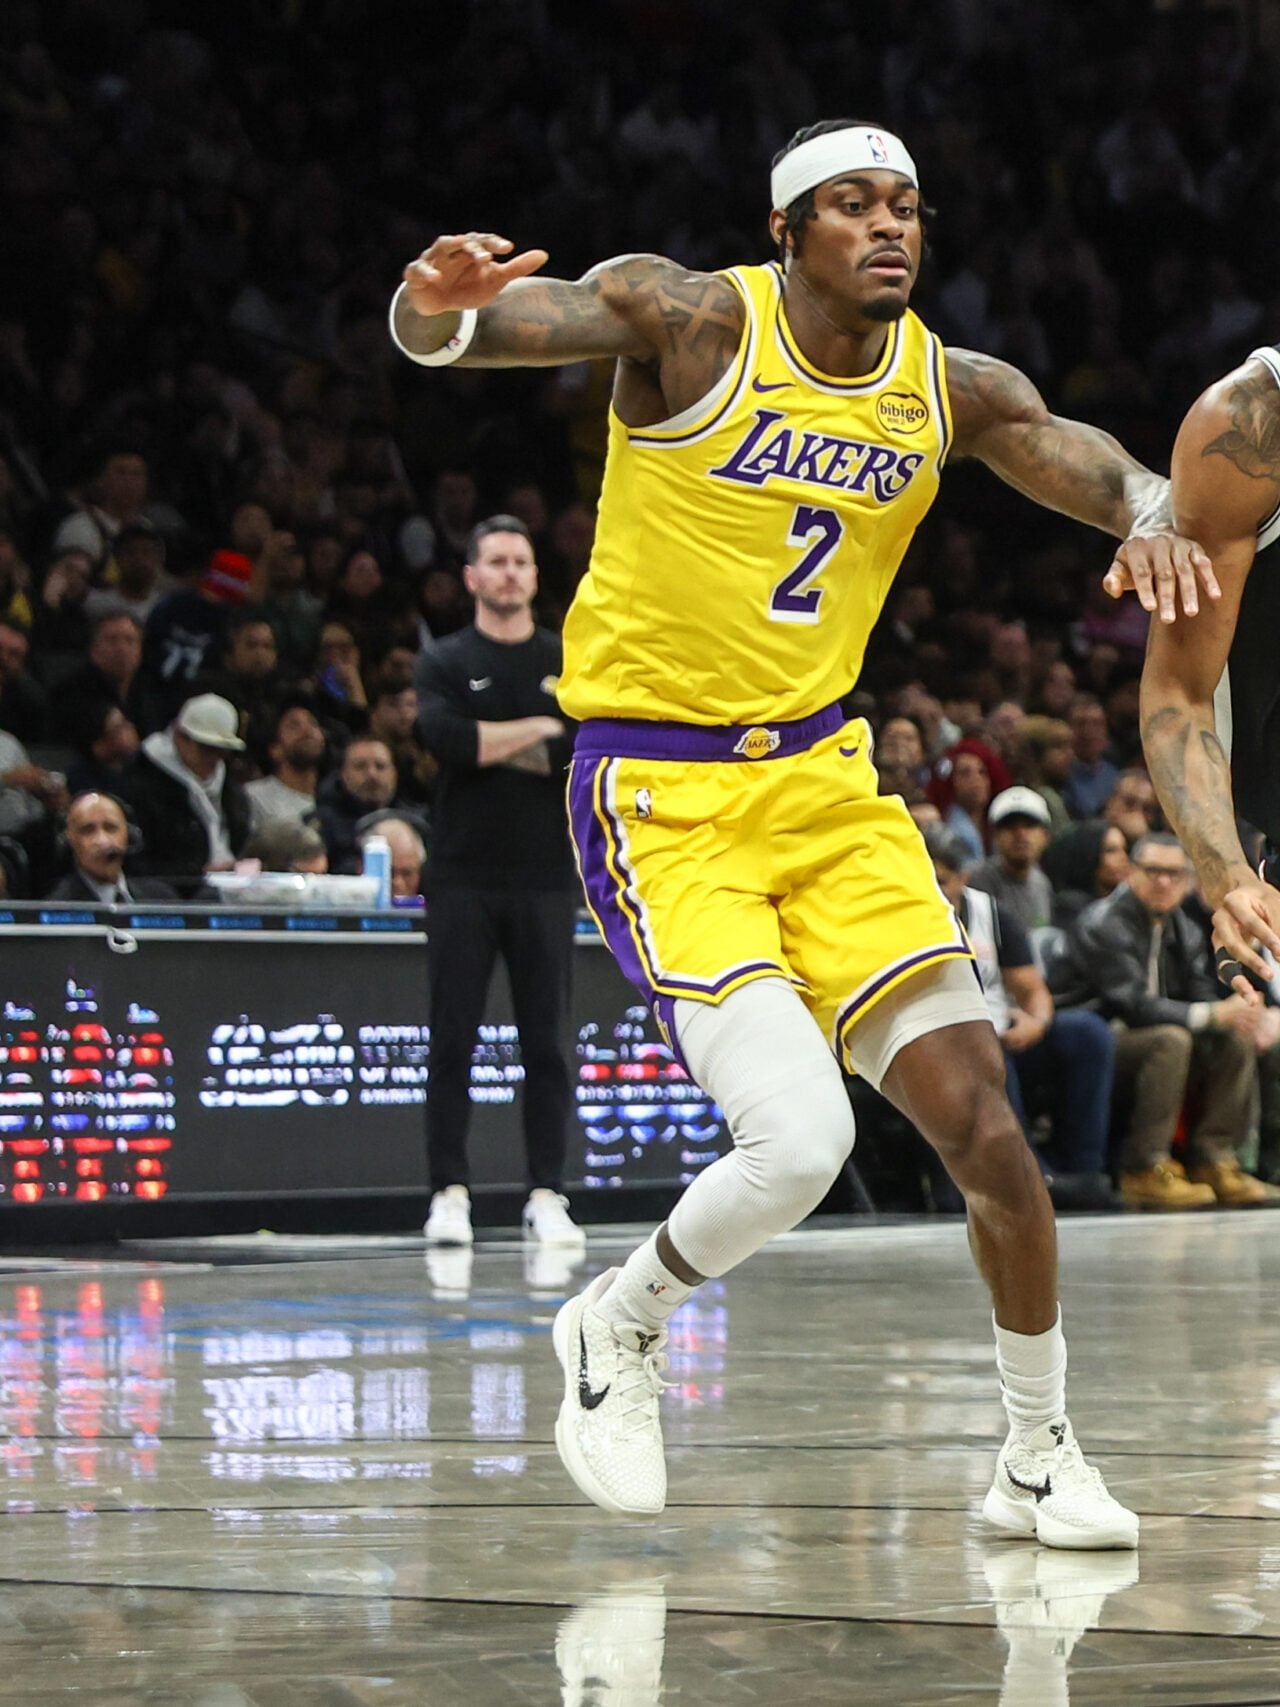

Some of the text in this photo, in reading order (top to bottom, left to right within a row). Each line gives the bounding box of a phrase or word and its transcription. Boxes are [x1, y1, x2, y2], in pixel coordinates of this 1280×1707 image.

[711, 409, 925, 502] LAKERS
[880, 402, 925, 423] bibigo
[769, 504, 843, 624] 2
